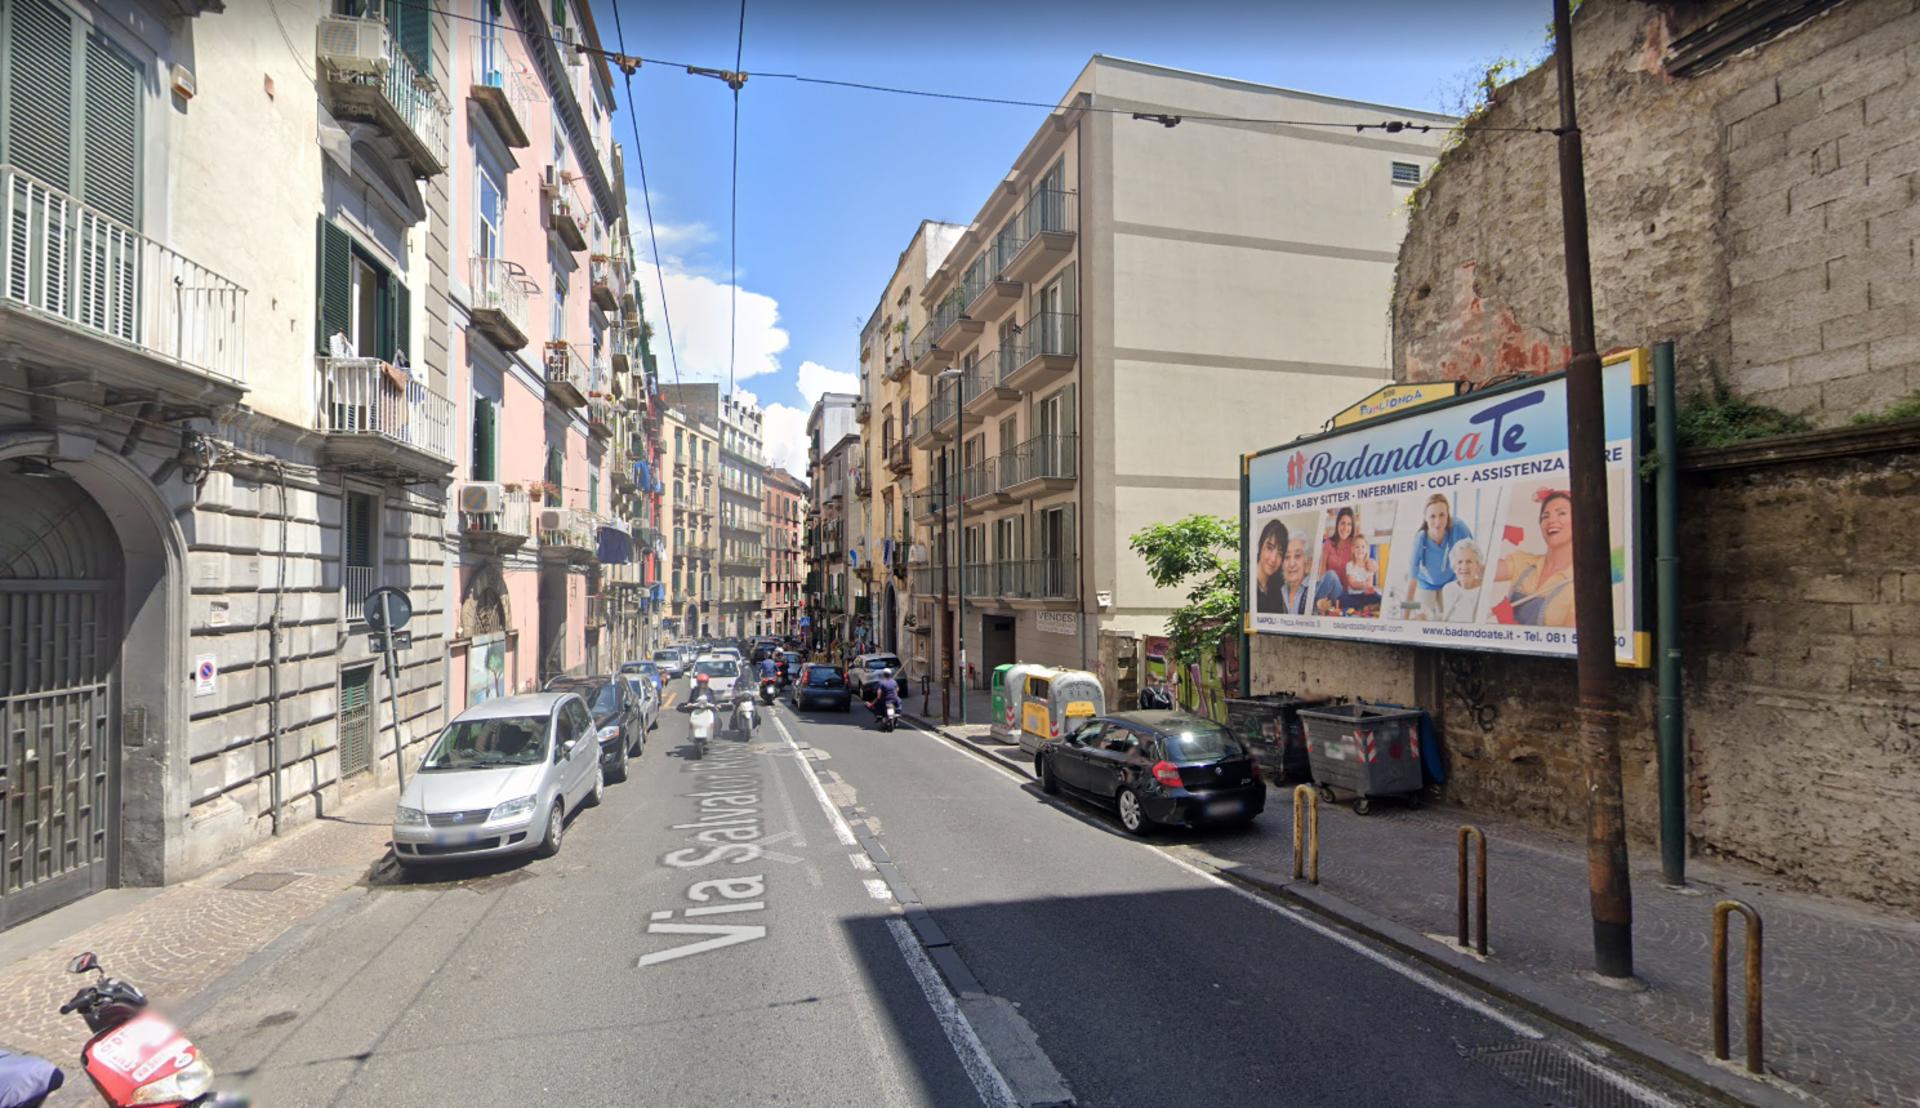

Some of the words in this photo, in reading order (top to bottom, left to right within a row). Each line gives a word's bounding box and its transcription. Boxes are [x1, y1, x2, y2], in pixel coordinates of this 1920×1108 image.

[1306, 429, 1452, 488] Badando
[1454, 432, 1482, 462] a
[1469, 389, 1546, 457] Te
[1257, 501, 1291, 514] BADANTI
[1296, 496, 1319, 509] BABY
[1320, 492, 1350, 505] SITTER
[1357, 481, 1418, 499] INFERMIERI
[1428, 474, 1462, 489] COLF
[1471, 457, 1565, 483] ASSISTENZA
[1422, 624, 1514, 640] www.badandoate.it
[1524, 631, 1543, 642] Tel.
[1546, 632, 1567, 643] 081
